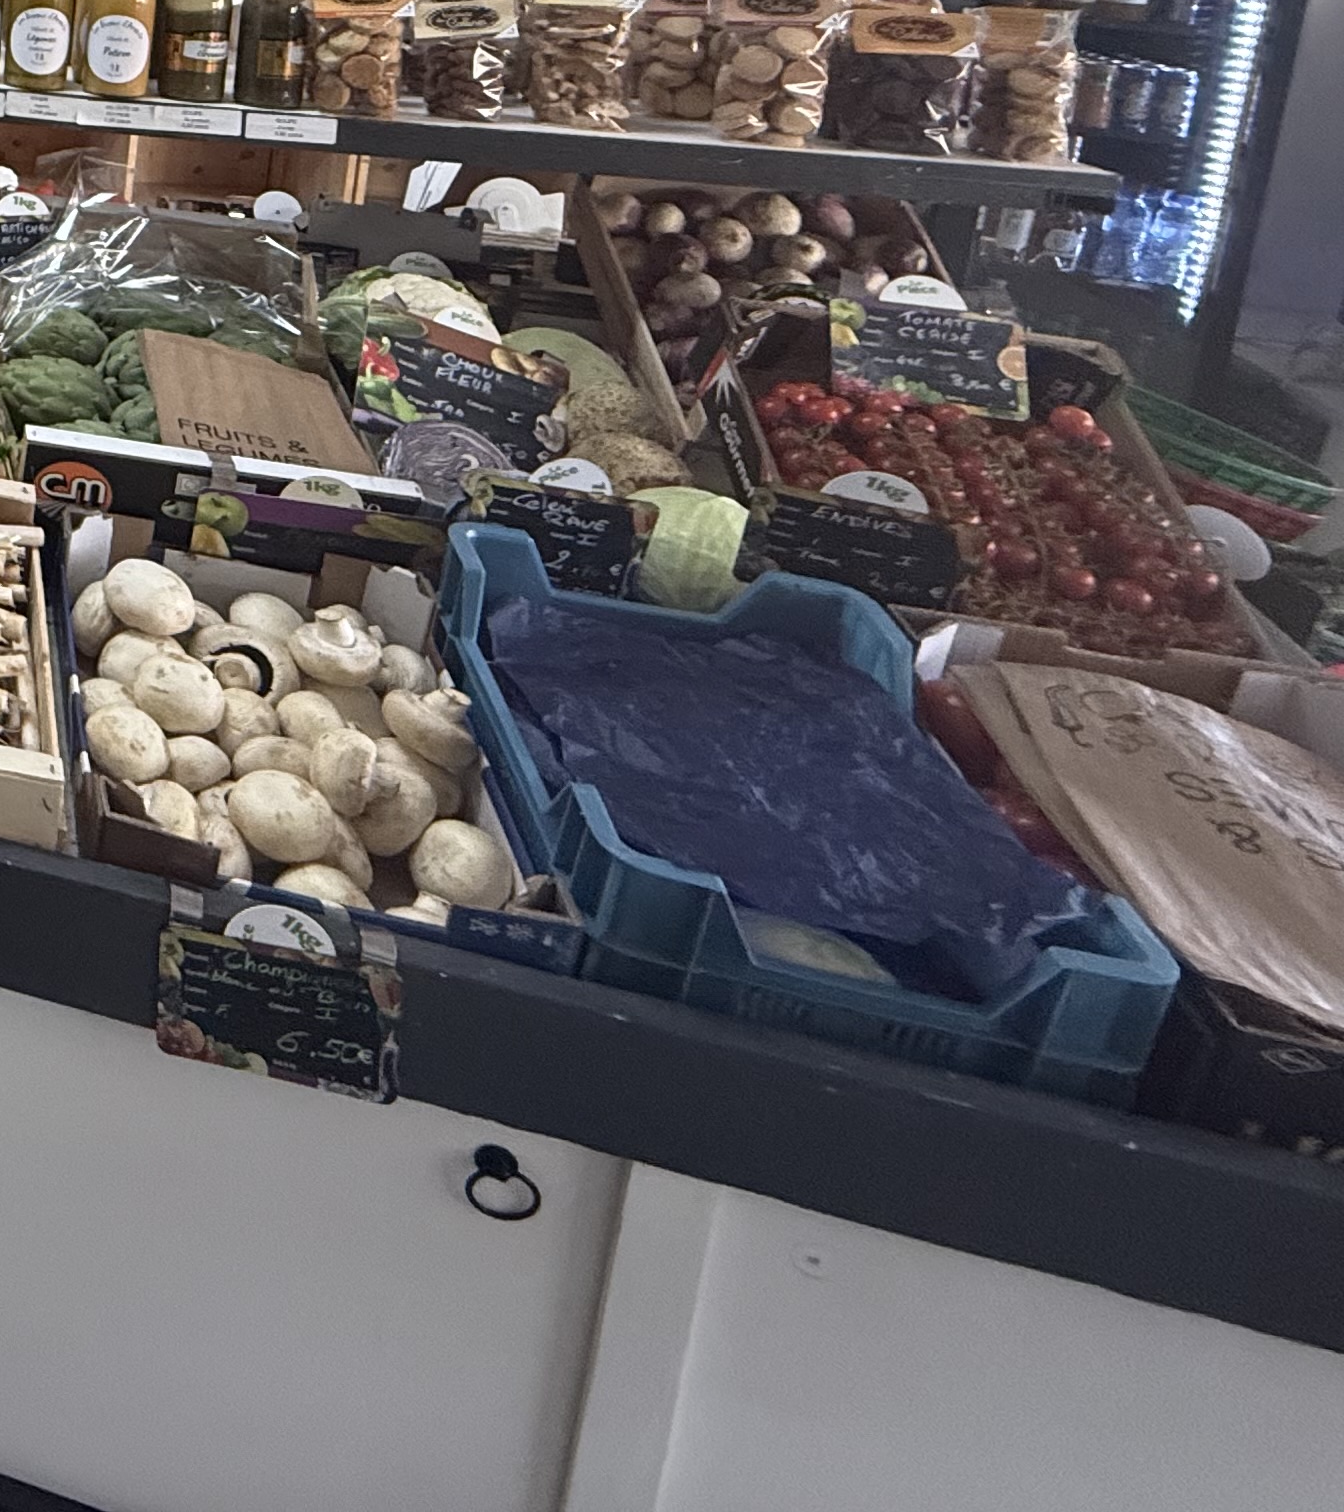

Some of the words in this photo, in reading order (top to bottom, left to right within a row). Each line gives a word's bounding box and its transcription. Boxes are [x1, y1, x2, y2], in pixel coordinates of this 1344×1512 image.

[12, 195, 38, 212] 1kg
[898, 310, 978, 332] TOMATE
[435, 367, 493, 395] FLEUR
[178, 417, 277, 448] FRUITS
[288, 440, 309, 455] &
[302, 480, 342, 497] 1kg
[811, 505, 913, 538] ENDIVES
[281, 913, 324, 957] 1kg
